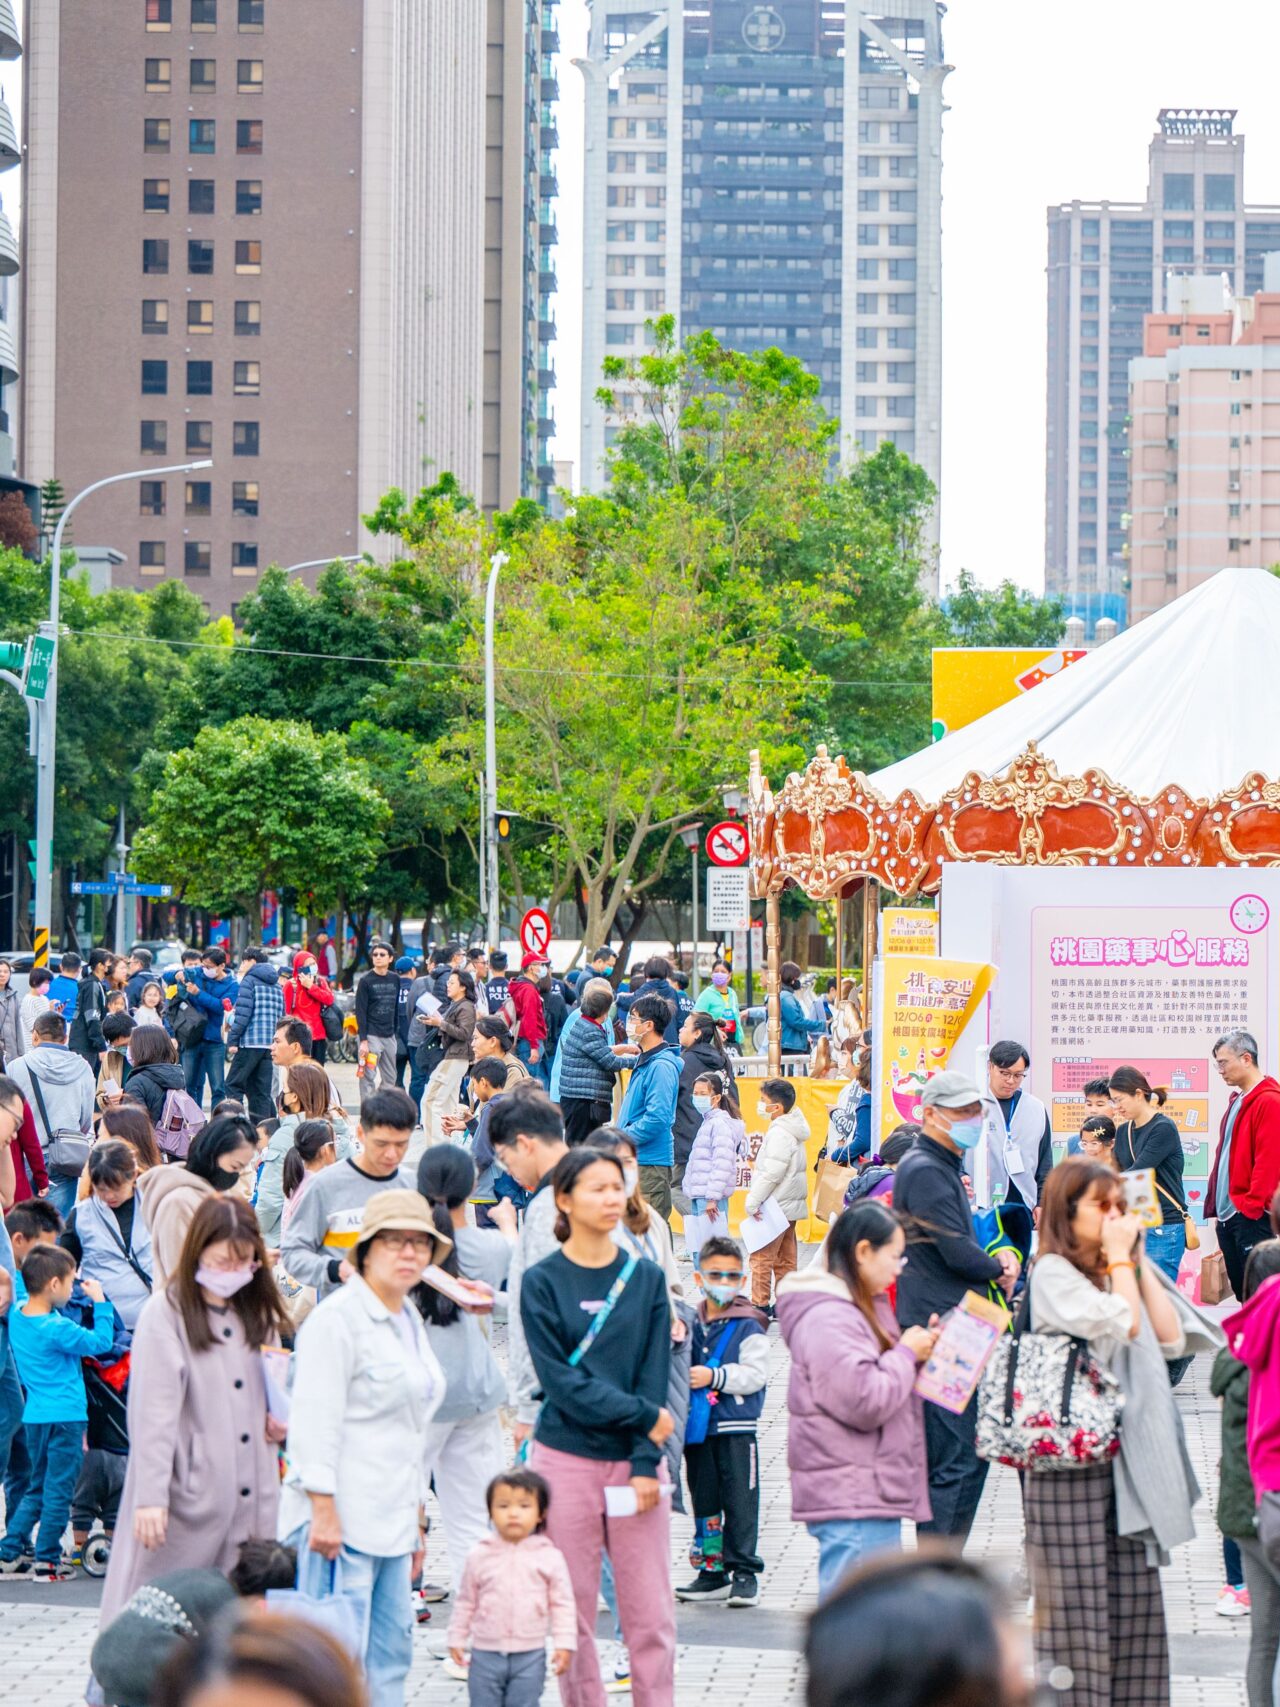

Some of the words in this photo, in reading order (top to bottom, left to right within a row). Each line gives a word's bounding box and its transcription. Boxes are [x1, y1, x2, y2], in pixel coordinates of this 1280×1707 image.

[1051, 930, 1249, 967] 桃園藥事心服務
[489, 992, 511, 1000] POLIC
